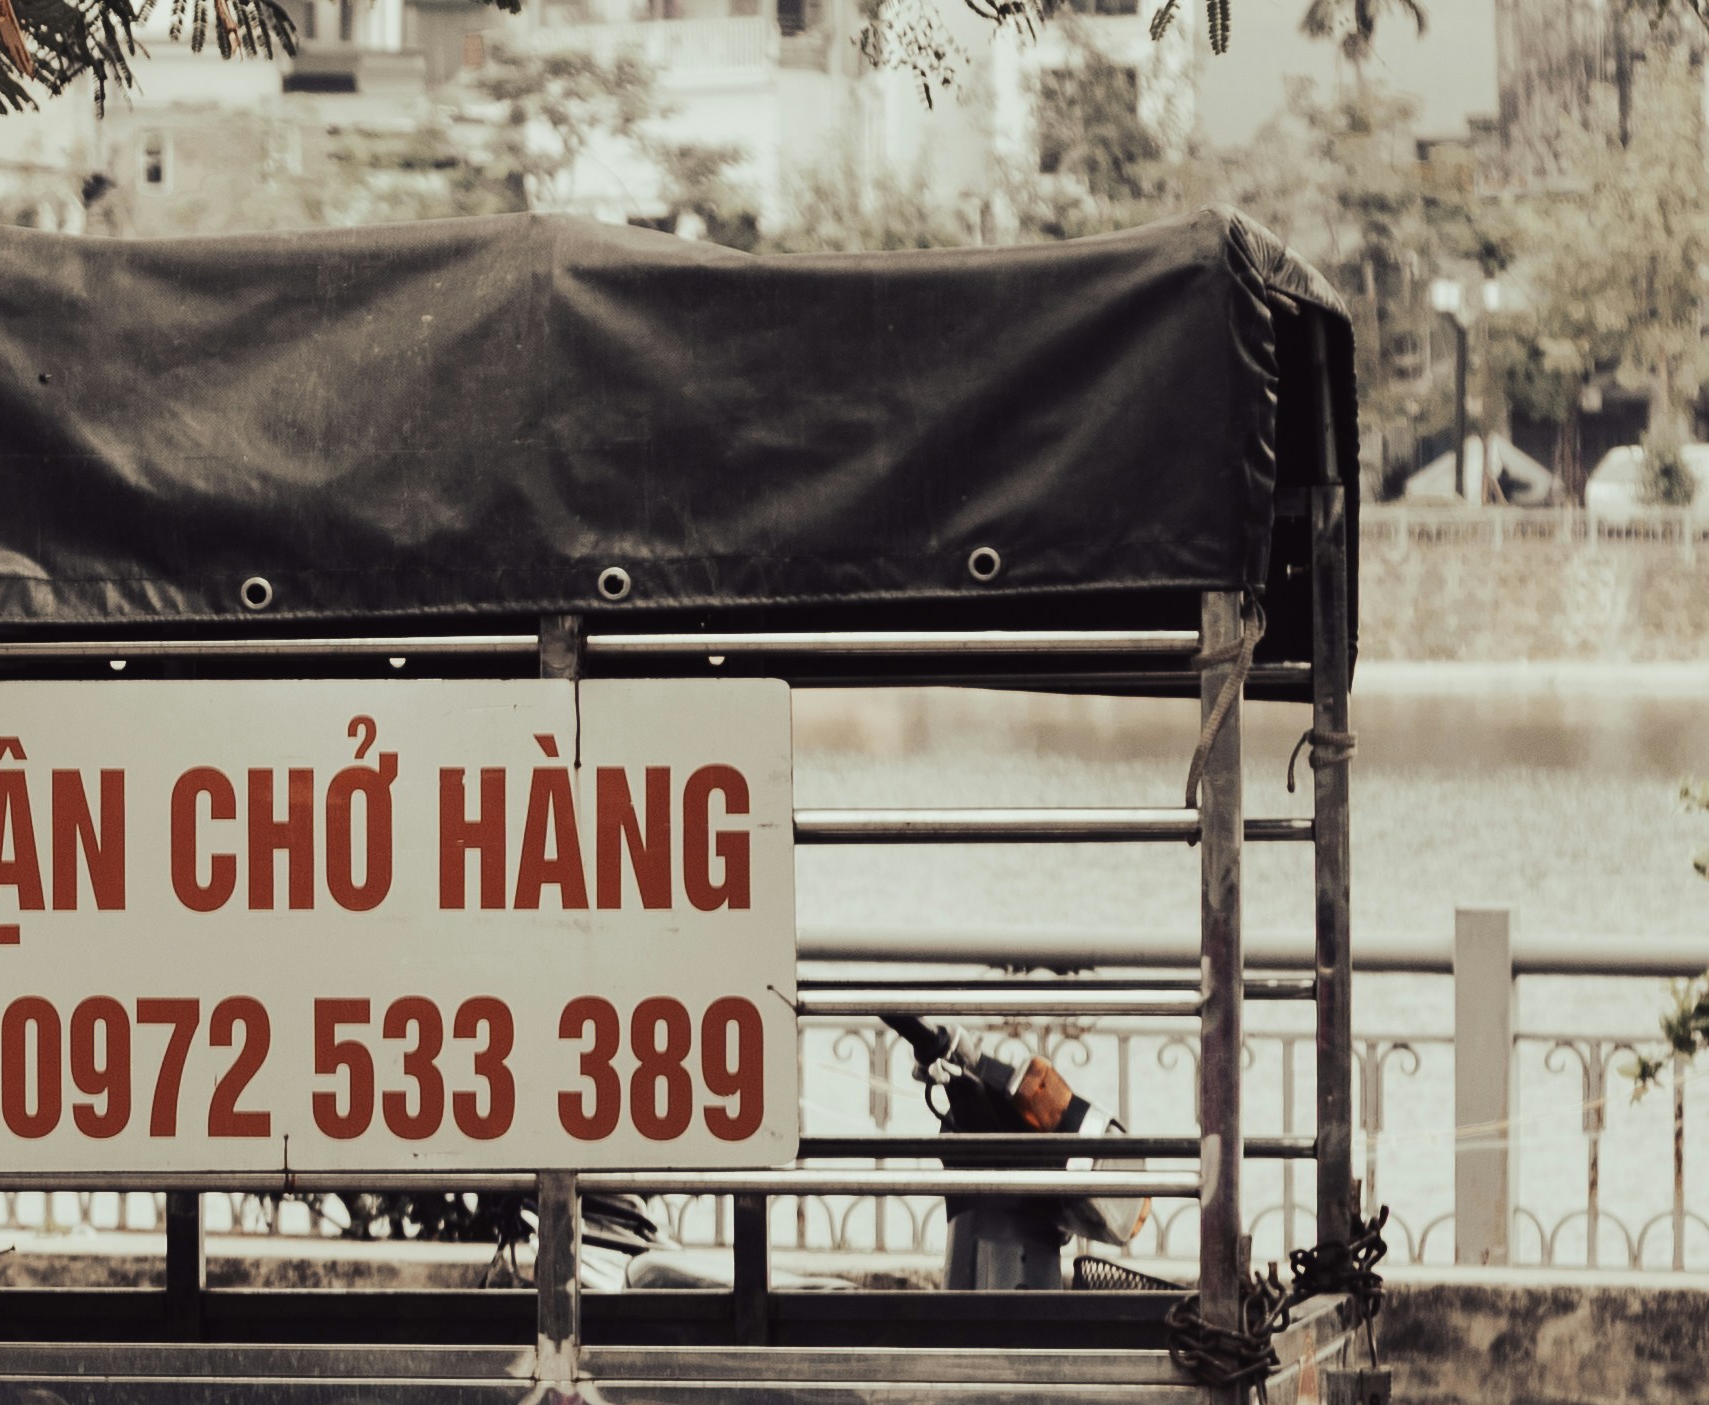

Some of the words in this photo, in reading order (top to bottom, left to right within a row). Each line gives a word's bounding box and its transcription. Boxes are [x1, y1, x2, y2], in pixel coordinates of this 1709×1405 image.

[172, 716, 398, 912] CHỞ
[439, 734, 750, 912] HÀNG
[1, 996, 271, 1139] 0972
[313, 996, 515, 1140] 533
[558, 996, 764, 1140] 389
